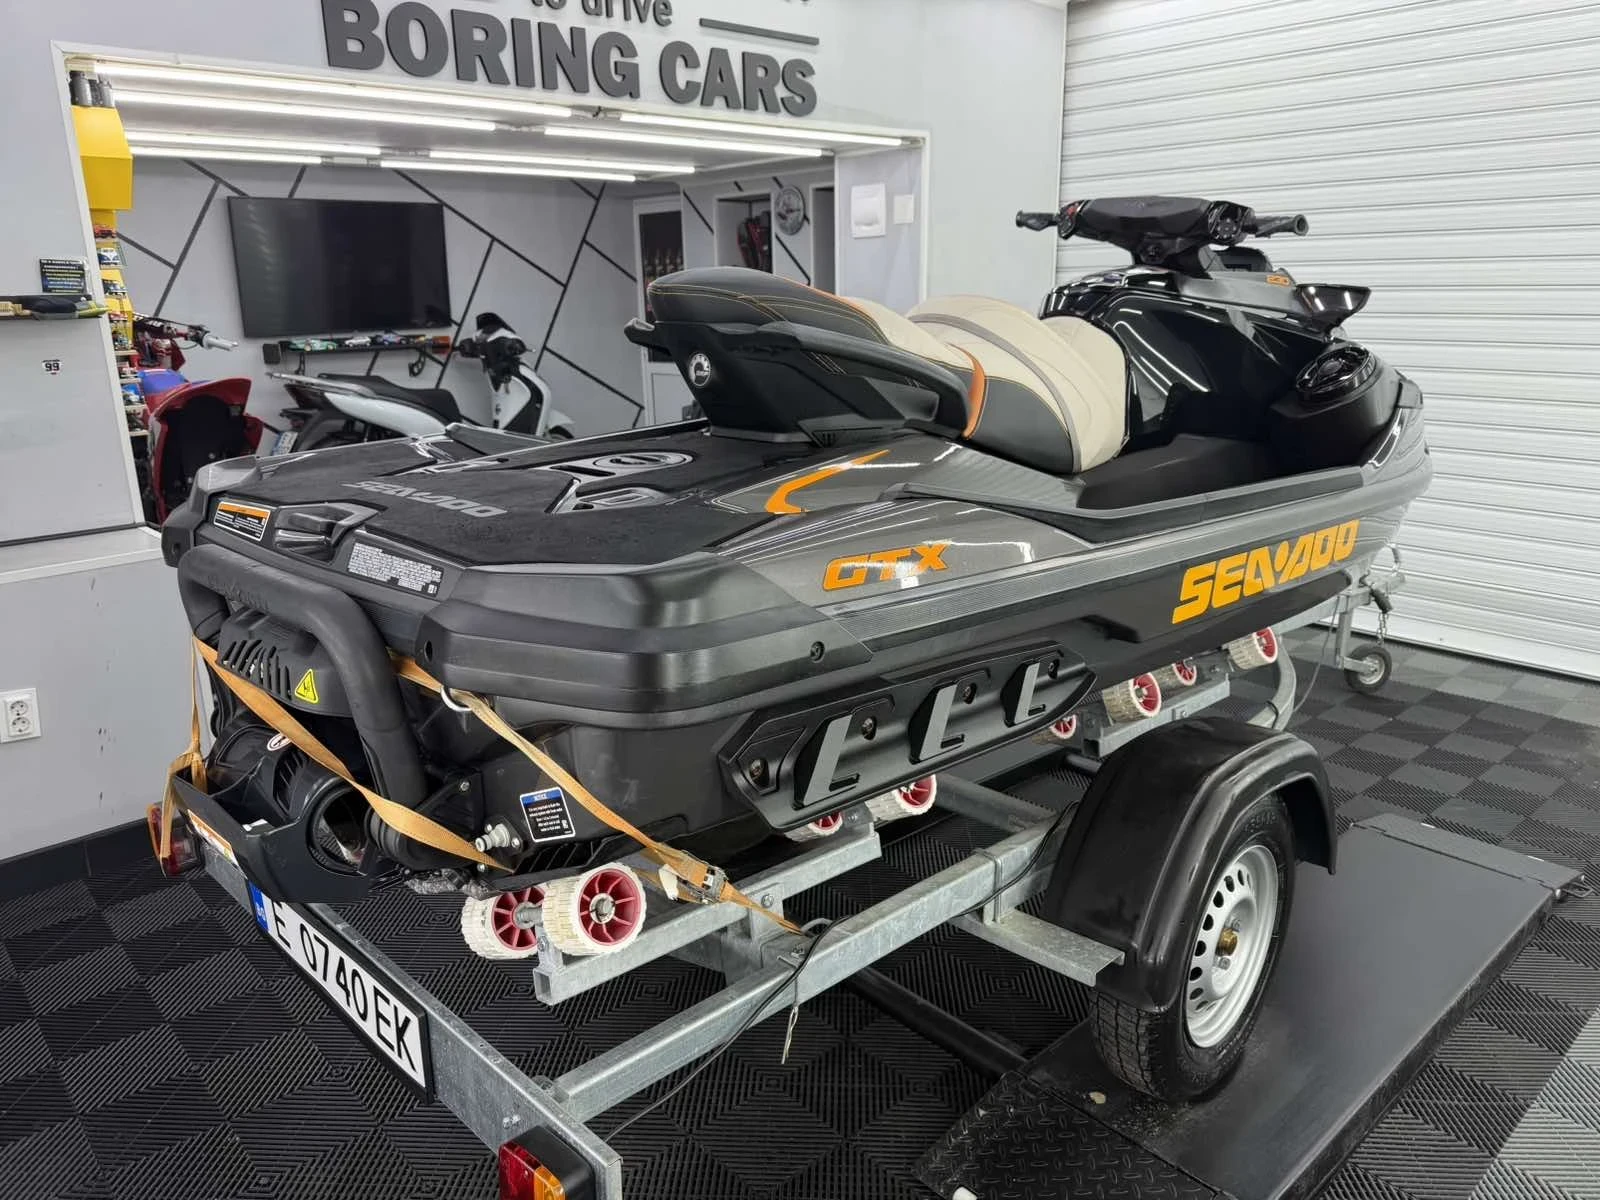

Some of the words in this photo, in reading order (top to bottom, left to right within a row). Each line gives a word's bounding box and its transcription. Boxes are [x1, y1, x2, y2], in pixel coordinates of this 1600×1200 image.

[321, 0, 641, 99] BORING
[659, 40, 818, 117] CARS
[44, 362, 60, 372] 99
[823, 543, 949, 592] GTX
[271, 900, 292, 950] E
